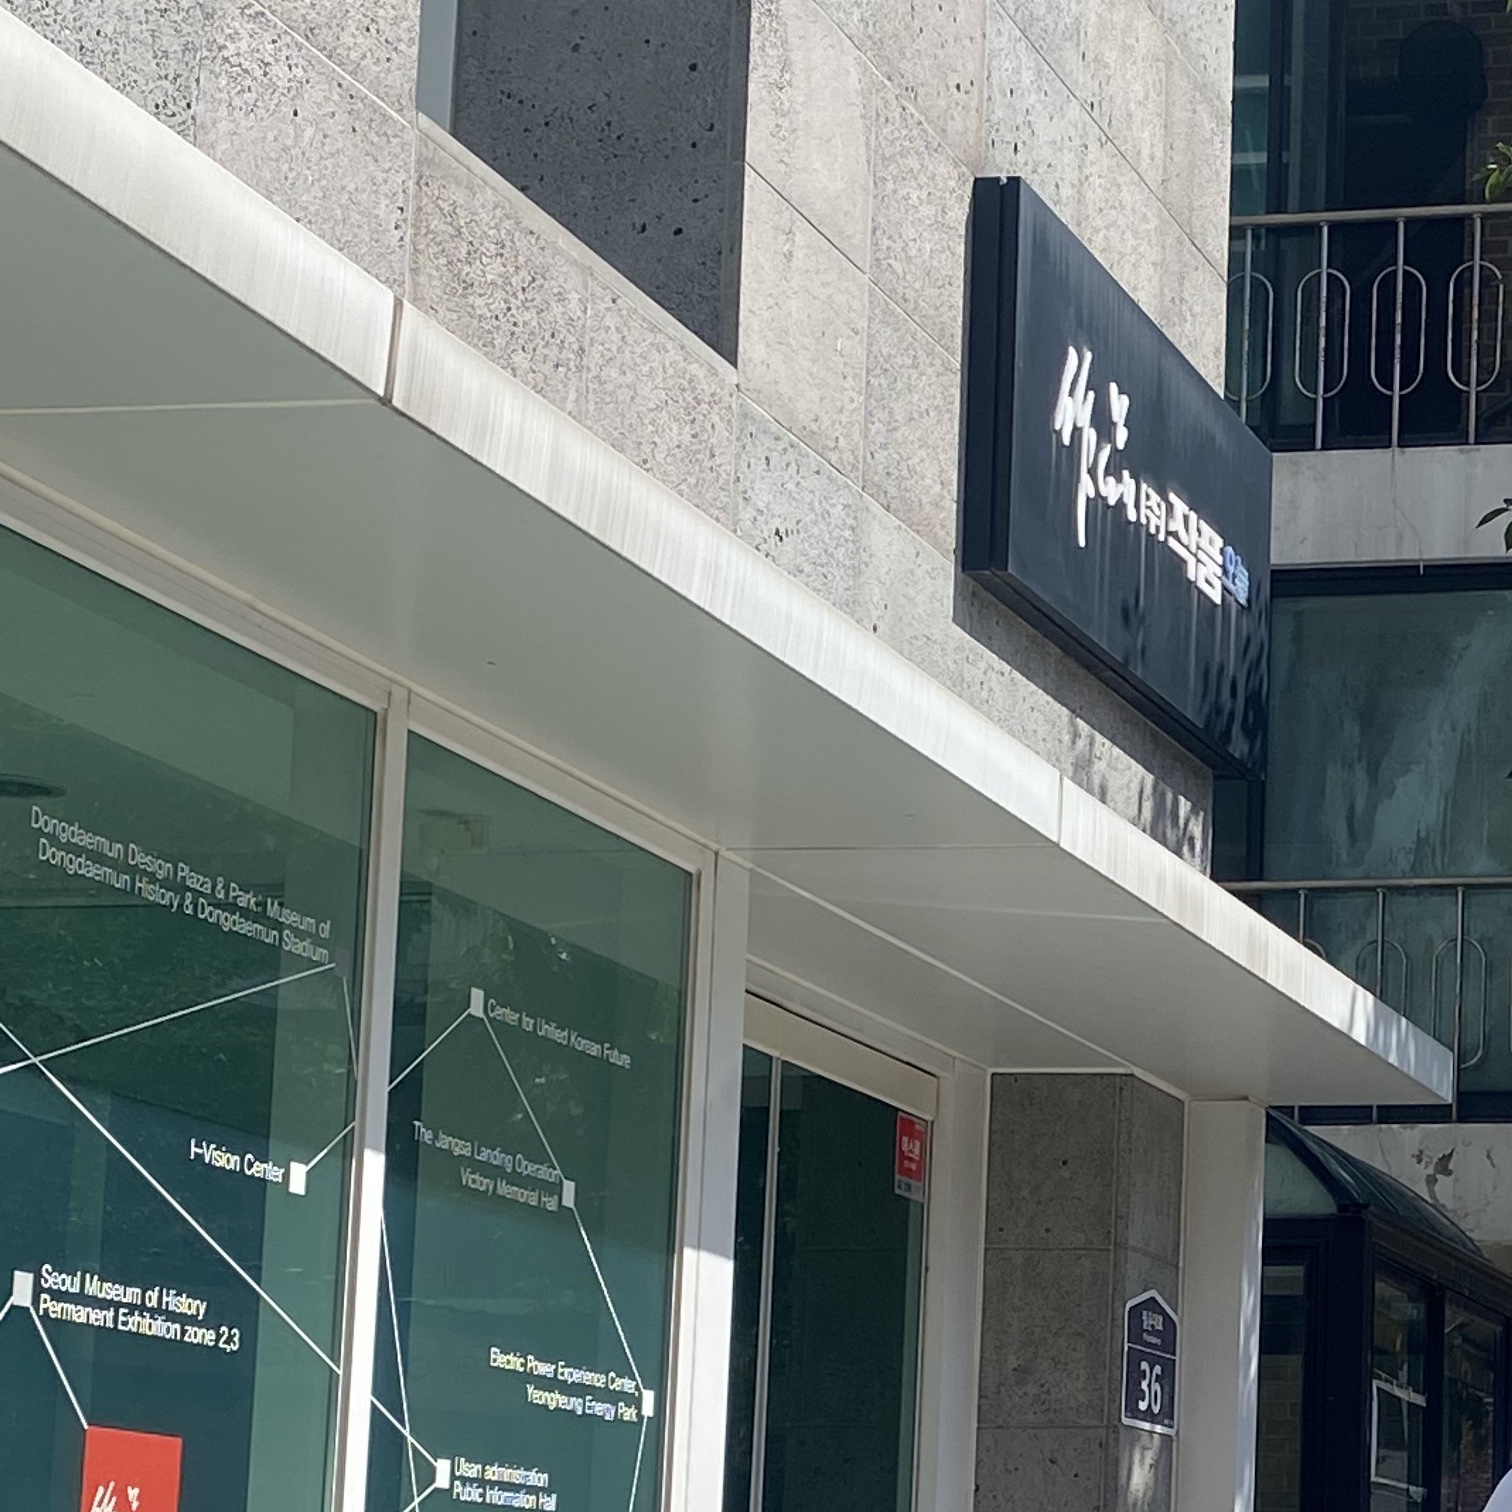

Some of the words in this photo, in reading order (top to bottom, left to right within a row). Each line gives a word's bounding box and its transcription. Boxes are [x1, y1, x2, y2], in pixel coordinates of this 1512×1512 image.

[31, 805, 124, 862] Dongdaemun
[128, 843, 173, 880] Design
[177, 861, 212, 895] Plaza
[215, 876, 225, 900] &
[267, 897, 316, 934] Museum
[319, 918, 331, 939] of
[38, 838, 131, 893] Dongdaemun
[134, 874, 180, 913] History
[183, 891, 194, 916] &
[198, 896, 280, 947] Dongdaemun
[282, 931, 329, 965] Stadium
[487, 998, 520, 1026] Center
[521, 1010, 535, 1032] for
[536, 1017, 569, 1046] Unified
[570, 1028, 602, 1058] Korean
[603, 1042, 632, 1069] Future
[243, 1153, 286, 1183] Center
[412, 1120, 433, 1145] The
[434, 1129, 472, 1157] Jangsa
[473, 1139, 513, 1173] Landing
[515, 1152, 562, 1185] Operation
[460, 1165, 495, 1197] Victory
[496, 1175, 539, 1208] Memorial
[540, 1190, 559, 1212] Hall
[40, 1263, 82, 1294] Seoul
[84, 1272, 142, 1306] Museum
[145, 1286, 160, 1309] of
[161, 1287, 208, 1322] History
[38, 1292, 116, 1330] Permanent
[117, 1307, 181, 1342] Exhibition
[183, 1324, 217, 1348] zone
[218, 1325, 241, 1353] 2,3
[490, 1347, 525, 1372] Electric
[526, 1354, 557, 1378] Power
[557, 1361, 607, 1389] Experience
[1137, 1360, 1163, 1415] 36
[585, 1395, 617, 1421] Energy
[617, 1401, 638, 1422] Park
[452, 1480, 484, 1503] Public
[485, 1484, 537, 1510] Information
[538, 1491, 557, 1512] Hall
[454, 1456, 483, 1480] Ulsan
[484, 1462, 549, 1488] administration
